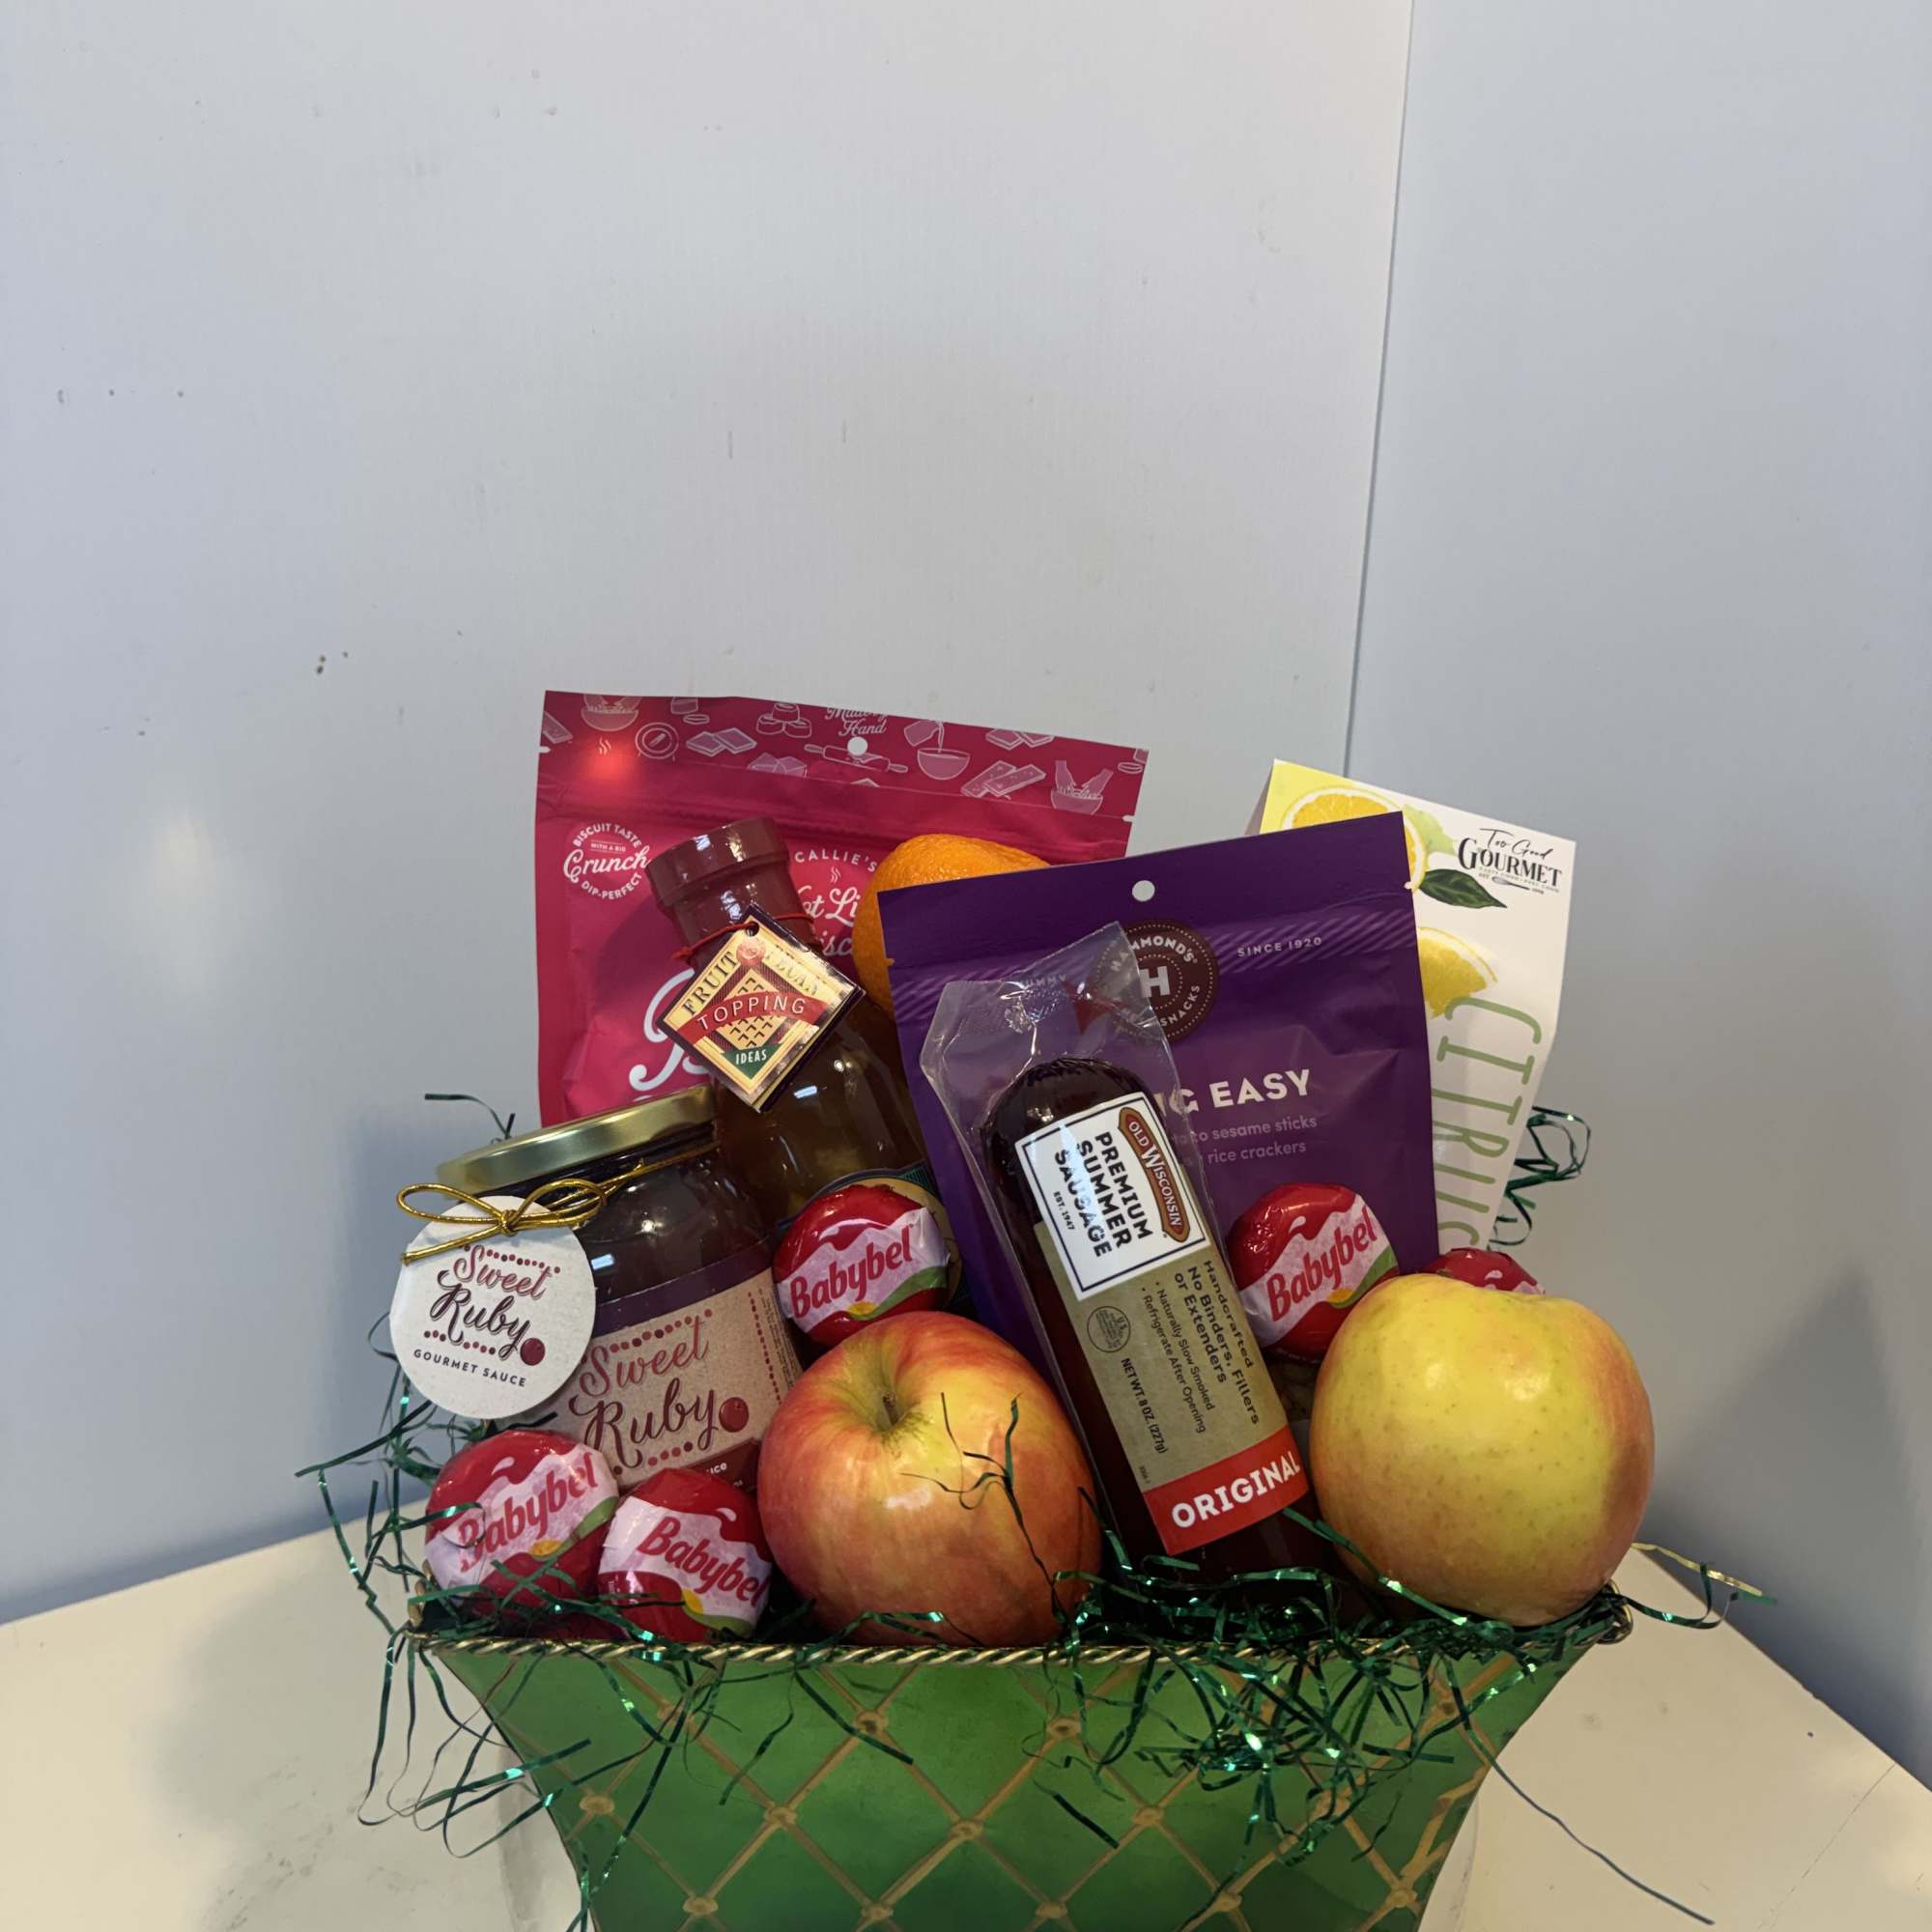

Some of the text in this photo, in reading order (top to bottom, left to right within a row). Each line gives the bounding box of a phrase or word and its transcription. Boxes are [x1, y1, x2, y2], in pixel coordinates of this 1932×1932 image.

[838, 718, 888, 736] Hand
[572, 822, 642, 848] BISCUIT TASTE
[795, 848, 877, 872] CALLIE'S
[1479, 828, 1554, 860] Too Good
[562, 845, 651, 884] Crunch
[581, 872, 642, 900] DIP-PERFECT
[1458, 838, 1562, 887] GOURMET
[1236, 936, 1322, 957] SINCE 1920
[682, 952, 737, 1015] FRUIT
[1140, 966, 1171, 998] H
[1160, 984, 1200, 1027] SNACKS
[696, 995, 808, 1030] TOPPING
[735, 1049, 768, 1065] IDEAS
[1208, 1069, 1310, 1108] EASY
[1128, 1122, 1150, 1147] OLD
[1208, 1148, 1236, 1165] rice
[1240, 1141, 1307, 1161] crackers
[1212, 1122, 1271, 1140] sesame
[1275, 1115, 1318, 1132] sticks
[1055, 1149, 1112, 1257] SAUSAGE
[1076, 1140, 1132, 1248] SUMMER
[1094, 1131, 1153, 1239] PREMIUM
[453, 1244, 554, 1300] Sweet
[790, 1225, 913, 1319] Babybel
[1266, 1206, 1378, 1322] Babybel
[429, 1269, 531, 1361] Ruby
[1175, 1273, 1227, 1384] or Extenders
[1204, 1261, 1254, 1369] Handcrafted
[413, 1349, 526, 1387] GOURMET SAUCE
[580, 1315, 710, 1397] Sweet
[1144, 1294, 1207, 1435] Refrigerate After Opening
[1158, 1289, 1215, 1411] Naturally Slow Smoked
[1188, 1266, 1203, 1292] No
[1232, 1369, 1260, 1425] Fillers
[568, 1378, 719, 1468] Ruby
[1172, 1450, 1300, 1528] ORIGINAL
[637, 1516, 770, 1608] Babybel
